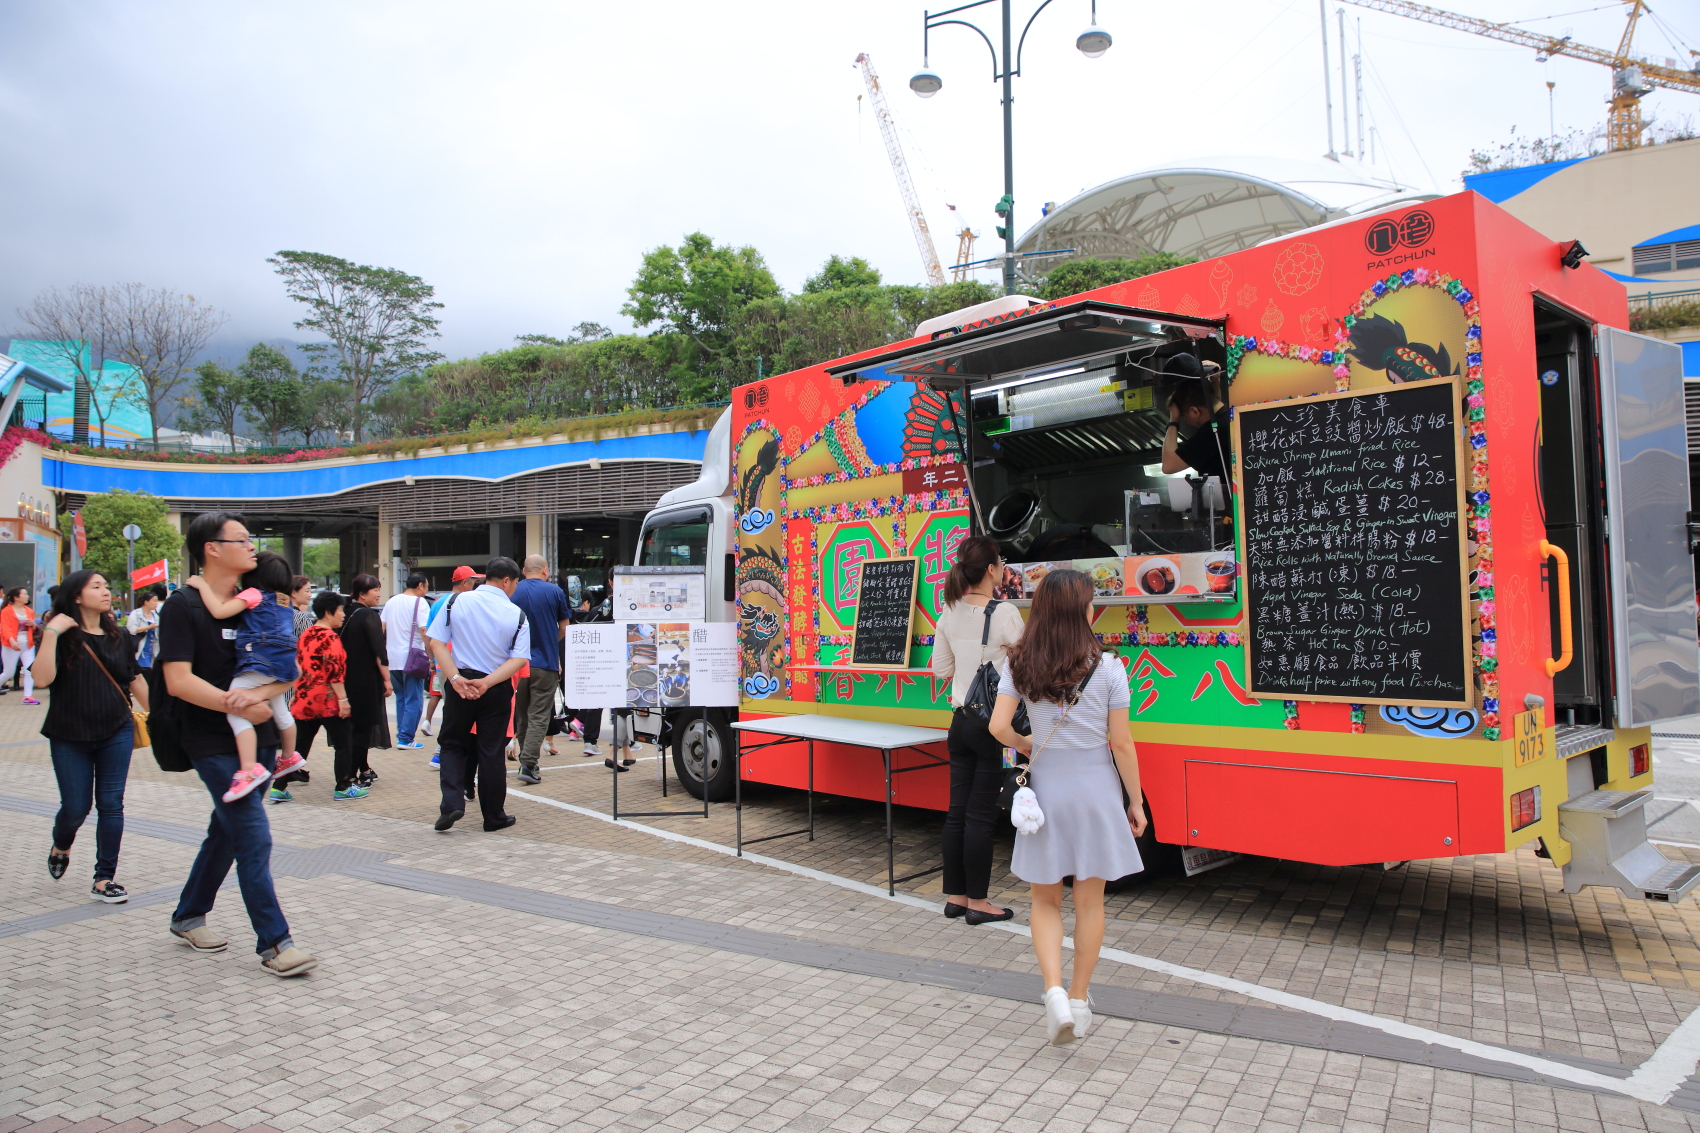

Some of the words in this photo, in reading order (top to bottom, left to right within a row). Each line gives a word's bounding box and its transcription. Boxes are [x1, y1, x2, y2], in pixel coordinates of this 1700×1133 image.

[1367, 247, 1436, 271] PATCHUN
[744, 408, 770, 418] PATCHUN
[1273, 394, 1390, 427] 八珍美食車
[1244, 454, 1280, 470] Sakura
[1282, 449, 1316, 465] Shrimp
[1320, 446, 1352, 460] Umami
[1391, 438, 1420, 451] Rice
[1258, 466, 1297, 485] 加飯
[1302, 460, 1357, 478] Additional
[1361, 457, 1387, 471] Rice
[1253, 480, 1315, 507] 蘿蔔糕
[1322, 476, 1364, 495] Radish
[1367, 474, 1404, 490] Cakes
[1248, 527, 1269, 540] Slow
[1325, 519, 1340, 536] Egg
[1343, 518, 1352, 532] &
[1356, 517, 1386, 533] Ginger
[1386, 516, 1395, 525] in
[1396, 512, 1420, 526] Sweet
[1422, 507, 1457, 528] Vinegar
[1251, 556, 1274, 569] Rice
[1276, 554, 1299, 567] Rolls
[1301, 552, 1322, 565] with
[1325, 550, 1364, 566] Naturally
[1366, 548, 1398, 563] Brewed
[1401, 549, 1443, 563] Sauce
[1260, 590, 1286, 607] Aged
[1290, 589, 1327, 606] Vinegar
[1336, 587, 1367, 601] Soda
[1371, 583, 1421, 602] (Cold)
[571, 629, 601, 645] 豉油
[693, 628, 708, 643] 醋
[1256, 624, 1284, 639] Brown
[1286, 624, 1317, 641] Sugar
[1320, 622, 1351, 640] Ginger
[1353, 623, 1387, 638] Drink
[1389, 619, 1431, 638] (Hot)
[1261, 635, 1297, 653] 熱茶
[1308, 637, 1329, 650] Hot
[1332, 637, 1351, 651] Tea
[1257, 670, 1288, 688] Drinks
[1289, 671, 1312, 692] half
[1314, 675, 1338, 692] price
[1340, 675, 1361, 687] with
[1361, 679, 1377, 695] any
[1379, 672, 1405, 693] food
[1523, 710, 1537, 737] UN
[1519, 733, 1544, 763] 9173
